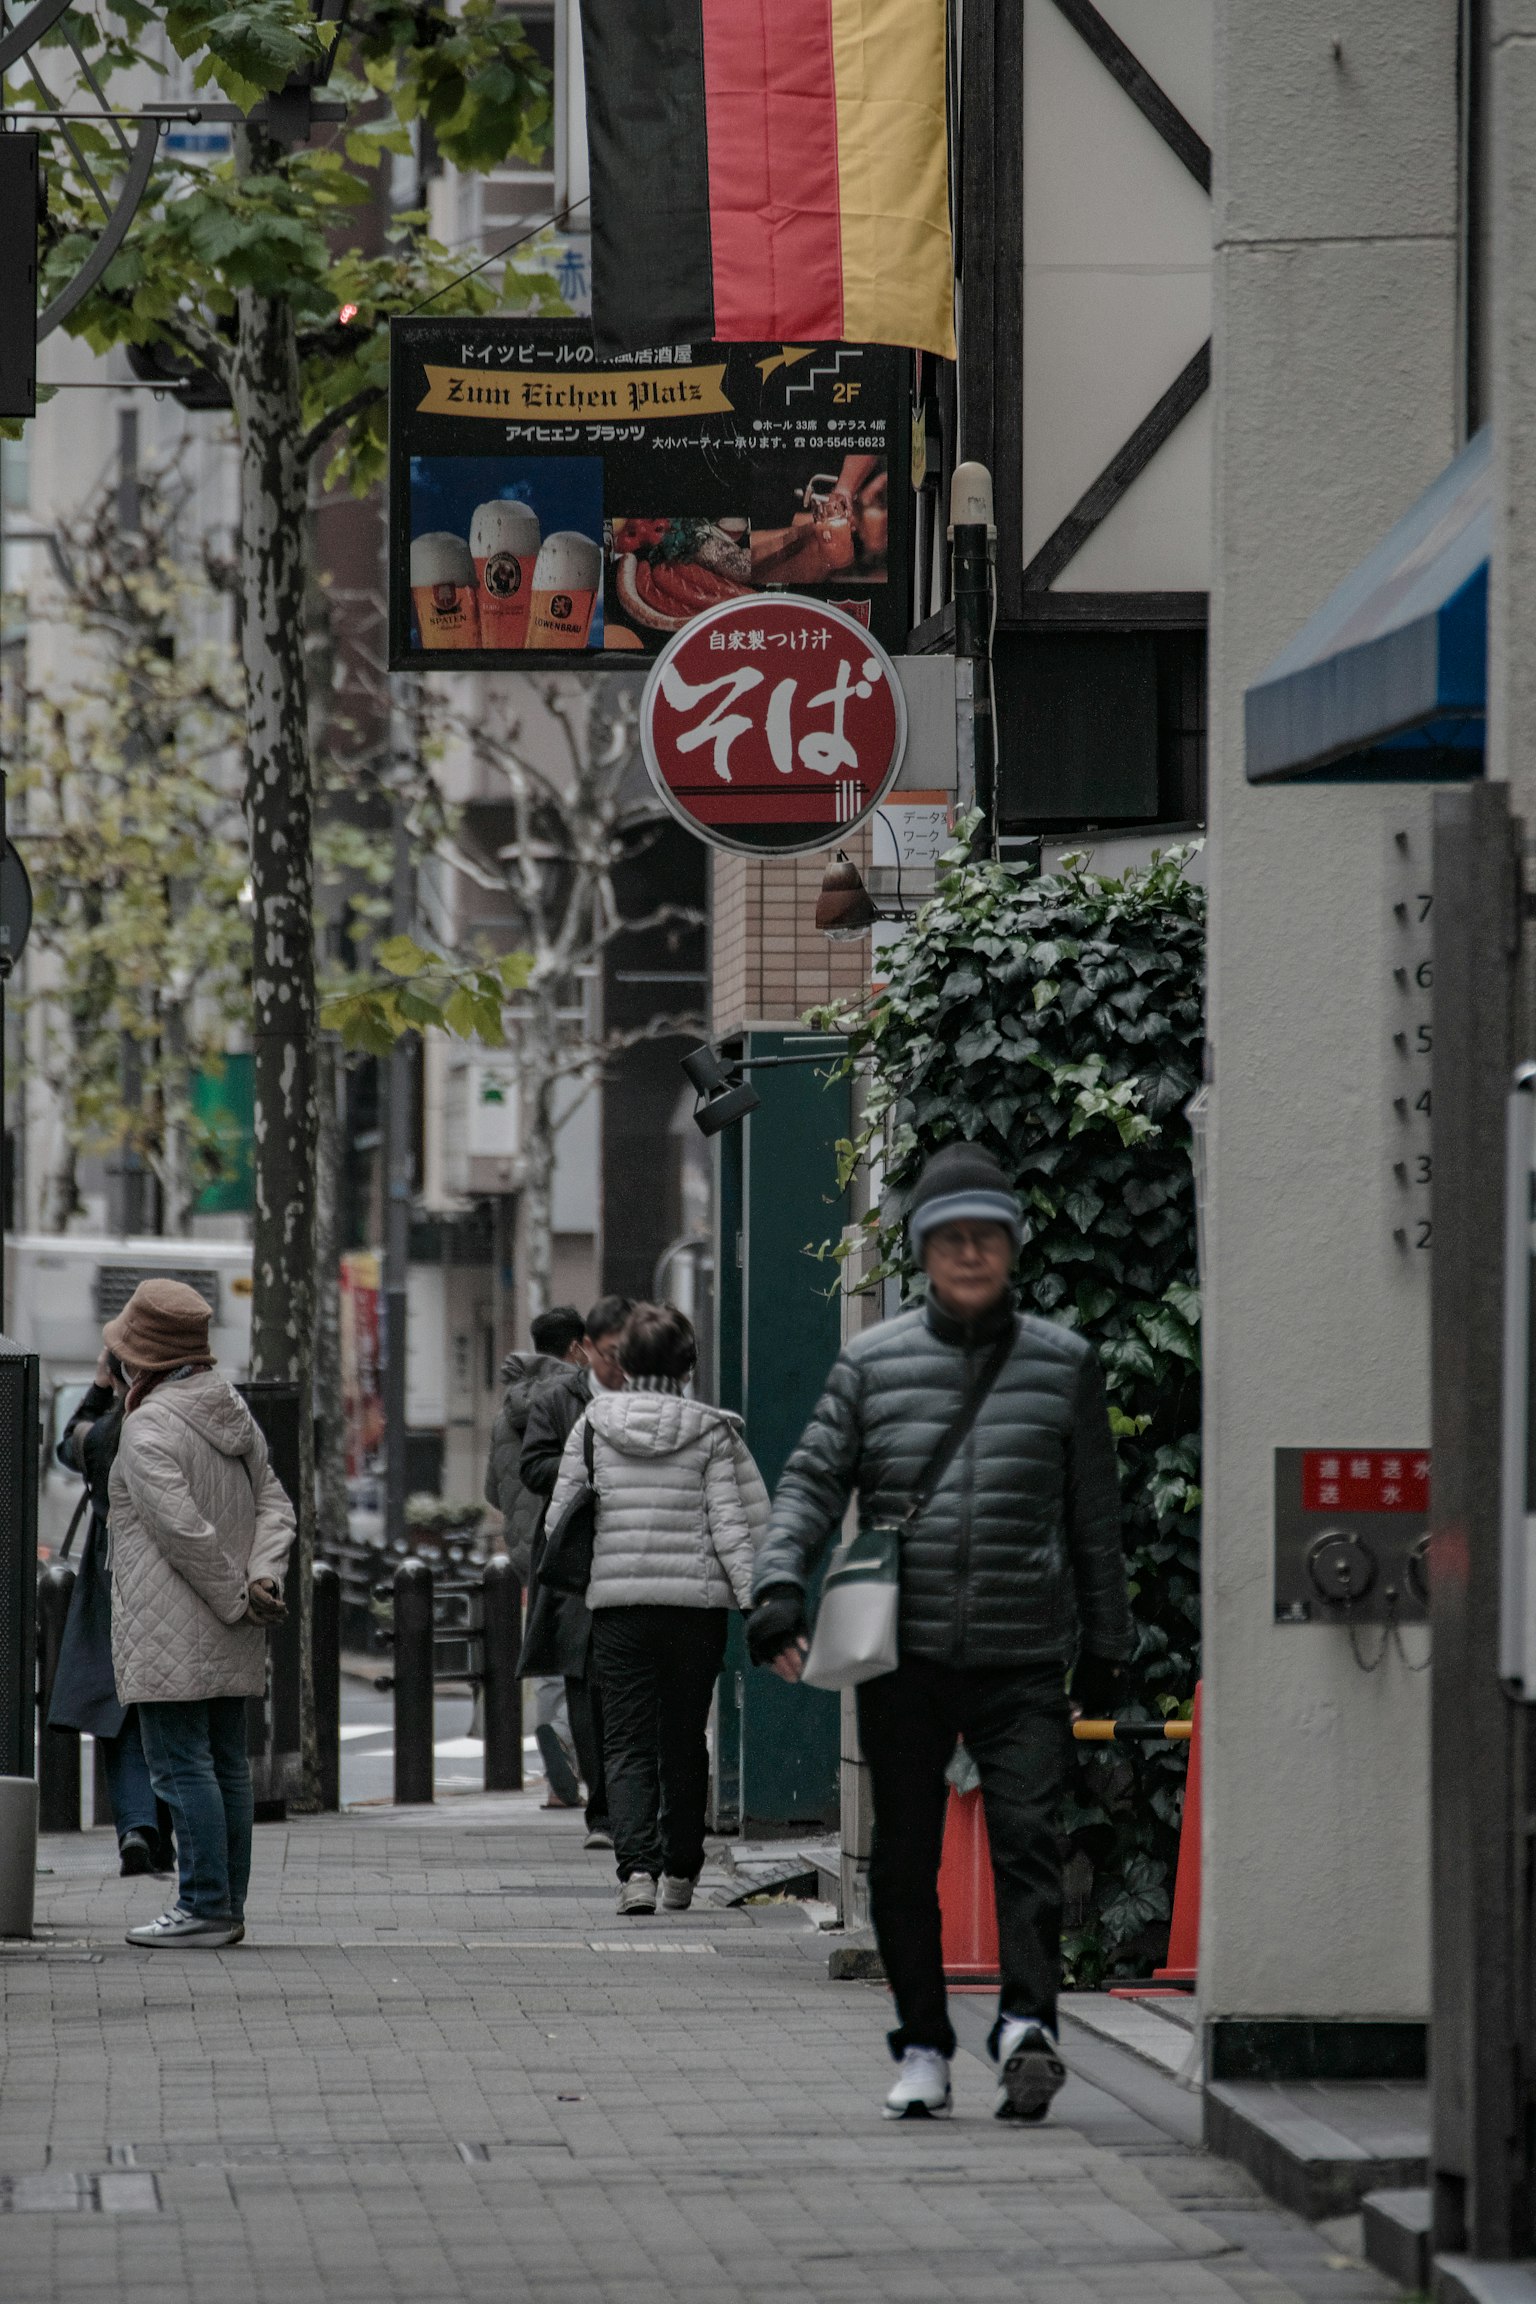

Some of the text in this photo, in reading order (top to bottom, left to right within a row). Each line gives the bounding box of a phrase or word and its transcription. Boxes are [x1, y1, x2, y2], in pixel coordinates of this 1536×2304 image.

[460, 344, 693, 364] ドイツビールの風居酒屋
[447, 378, 703, 412] Zum Eichen Platz
[832, 383, 862, 403] 2F
[506, 426, 645, 441] アイヒェン プラッツ
[809, 436, 886, 448] 03-5545-6623
[708, 628, 833, 650] 自家製つけ汁
[660, 657, 883, 783] そば
[904, 830, 939, 842] ワーク
[904, 847, 943, 861] アーカ
[1415, 895, 1433, 922] 7
[1415, 961, 1433, 989] 6
[1415, 1026, 1433, 1054] 5
[1415, 1090, 1433, 1117] 4
[1415, 1157, 1433, 1184] 3
[1415, 1223, 1433, 1250] 2
